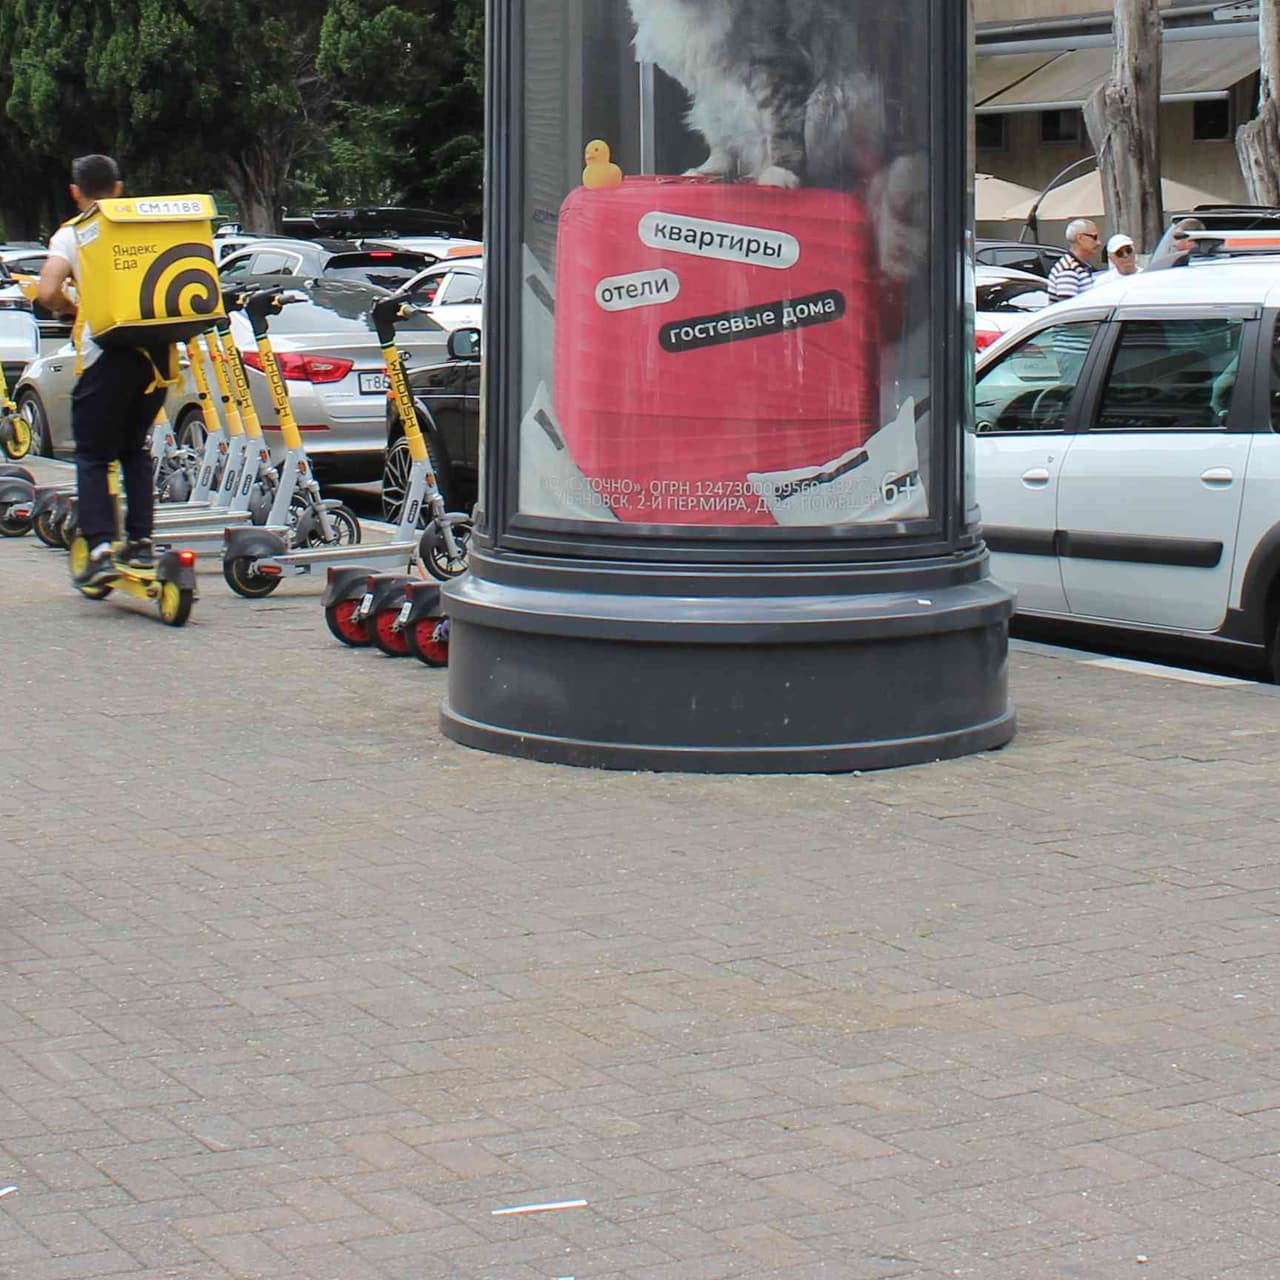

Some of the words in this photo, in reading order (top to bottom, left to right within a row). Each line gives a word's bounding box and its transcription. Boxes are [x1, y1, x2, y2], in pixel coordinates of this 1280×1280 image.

[112, 243, 158, 257] Яндекс
[653, 221, 784, 259] квартиры
[114, 258, 138, 270] Еда
[601, 276, 670, 303] отели
[669, 308, 776, 344] гостевые
[781, 296, 836, 326] дома
[226, 345, 251, 409] WHOOSH
[263, 351, 289, 417] WHOOSH
[389, 359, 417, 429] WHOOSH
[650, 479, 691, 497] ОГРН
[881, 471, 917, 505] 6+
